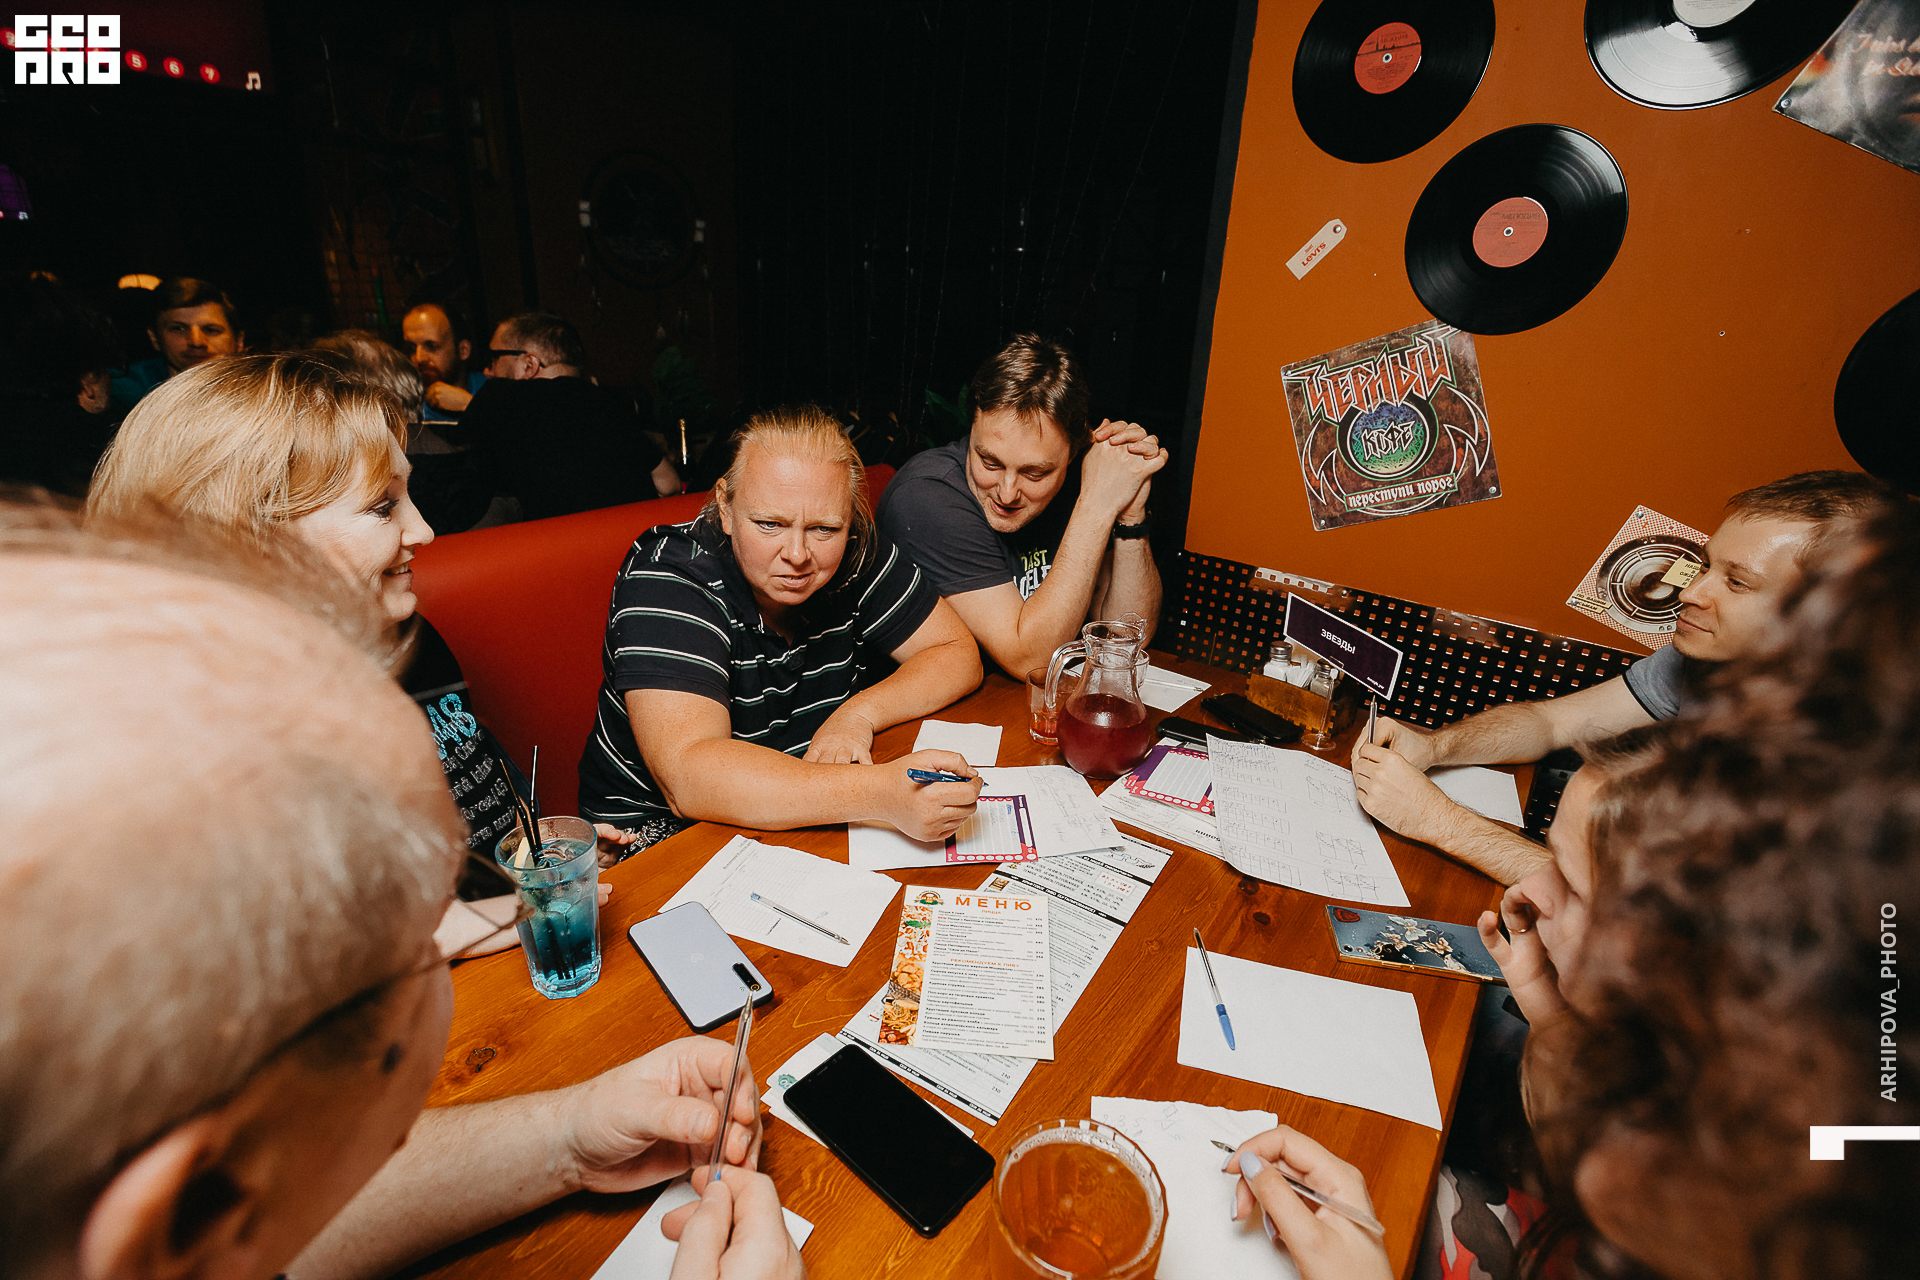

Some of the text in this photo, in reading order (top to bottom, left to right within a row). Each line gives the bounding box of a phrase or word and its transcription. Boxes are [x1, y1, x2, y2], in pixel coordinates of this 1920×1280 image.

[1349, 477, 1454, 508] переступи порог
[1320, 628, 1356, 654] ЗВЕЗДЫ
[956, 896, 1032, 911] МЕНЮ
